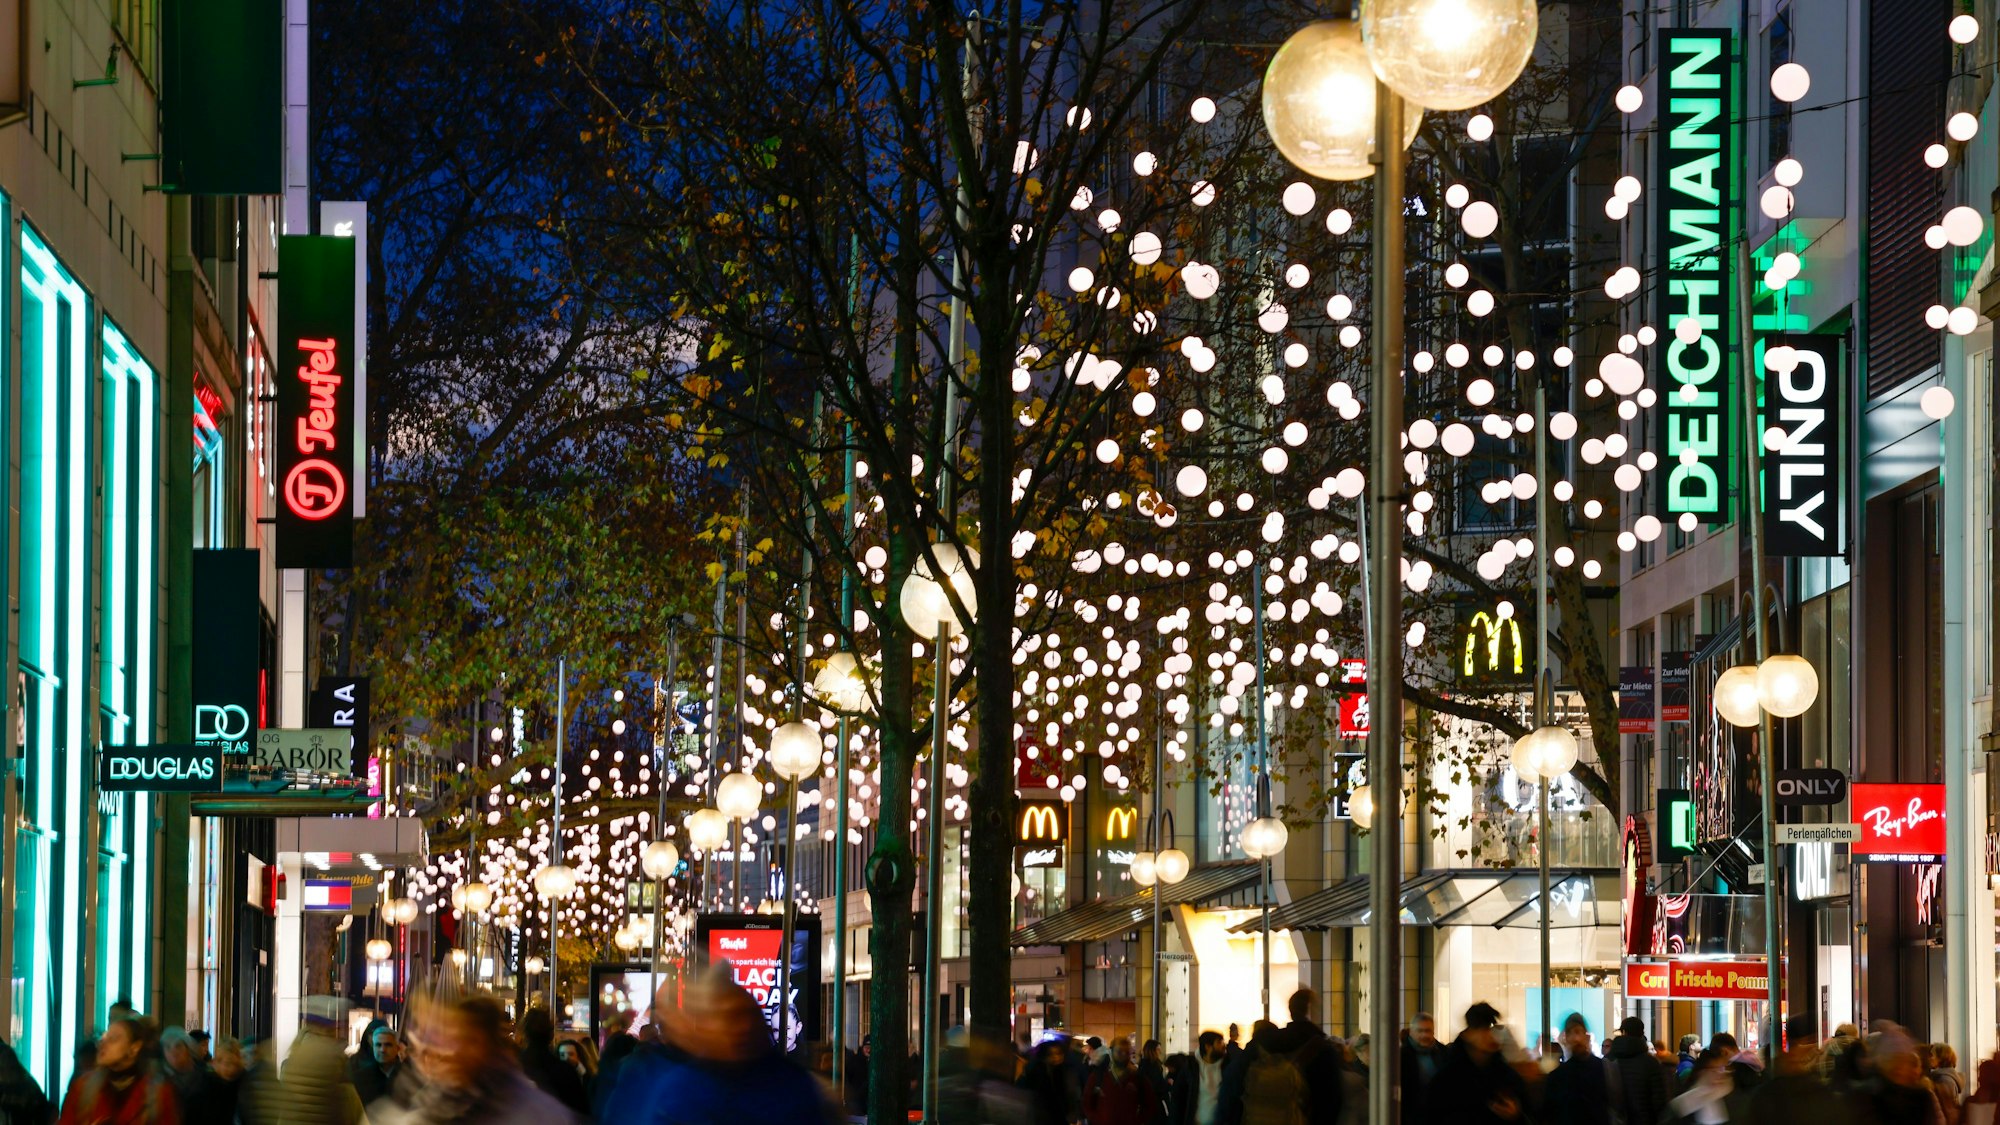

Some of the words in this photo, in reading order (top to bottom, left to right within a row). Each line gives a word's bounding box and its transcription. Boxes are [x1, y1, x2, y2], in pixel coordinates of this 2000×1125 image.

[1667, 37, 1722, 513] DEICHMANN
[298, 337, 341, 454] Teufel
[1779, 349, 1826, 541] ONLY
[1633, 682, 1652, 690] Miete
[195, 740, 249, 754] GLAS
[255, 746, 345, 770] BABOR
[109, 756, 214, 780] DOUGLAS
[1776, 778, 1841, 796] ONLY
[1787, 827, 1852, 841] Perlengäßchen
[1795, 842, 1832, 901] ONLY
[719, 937, 748, 950] Teufel
[736, 959, 753, 967] spart
[754, 958, 768, 966] sich
[732, 968, 793, 987] LACK
[1675, 968, 1724, 988] Frische
[1727, 971, 1787, 991] Pomms
[744, 988, 799, 1007] DAY
